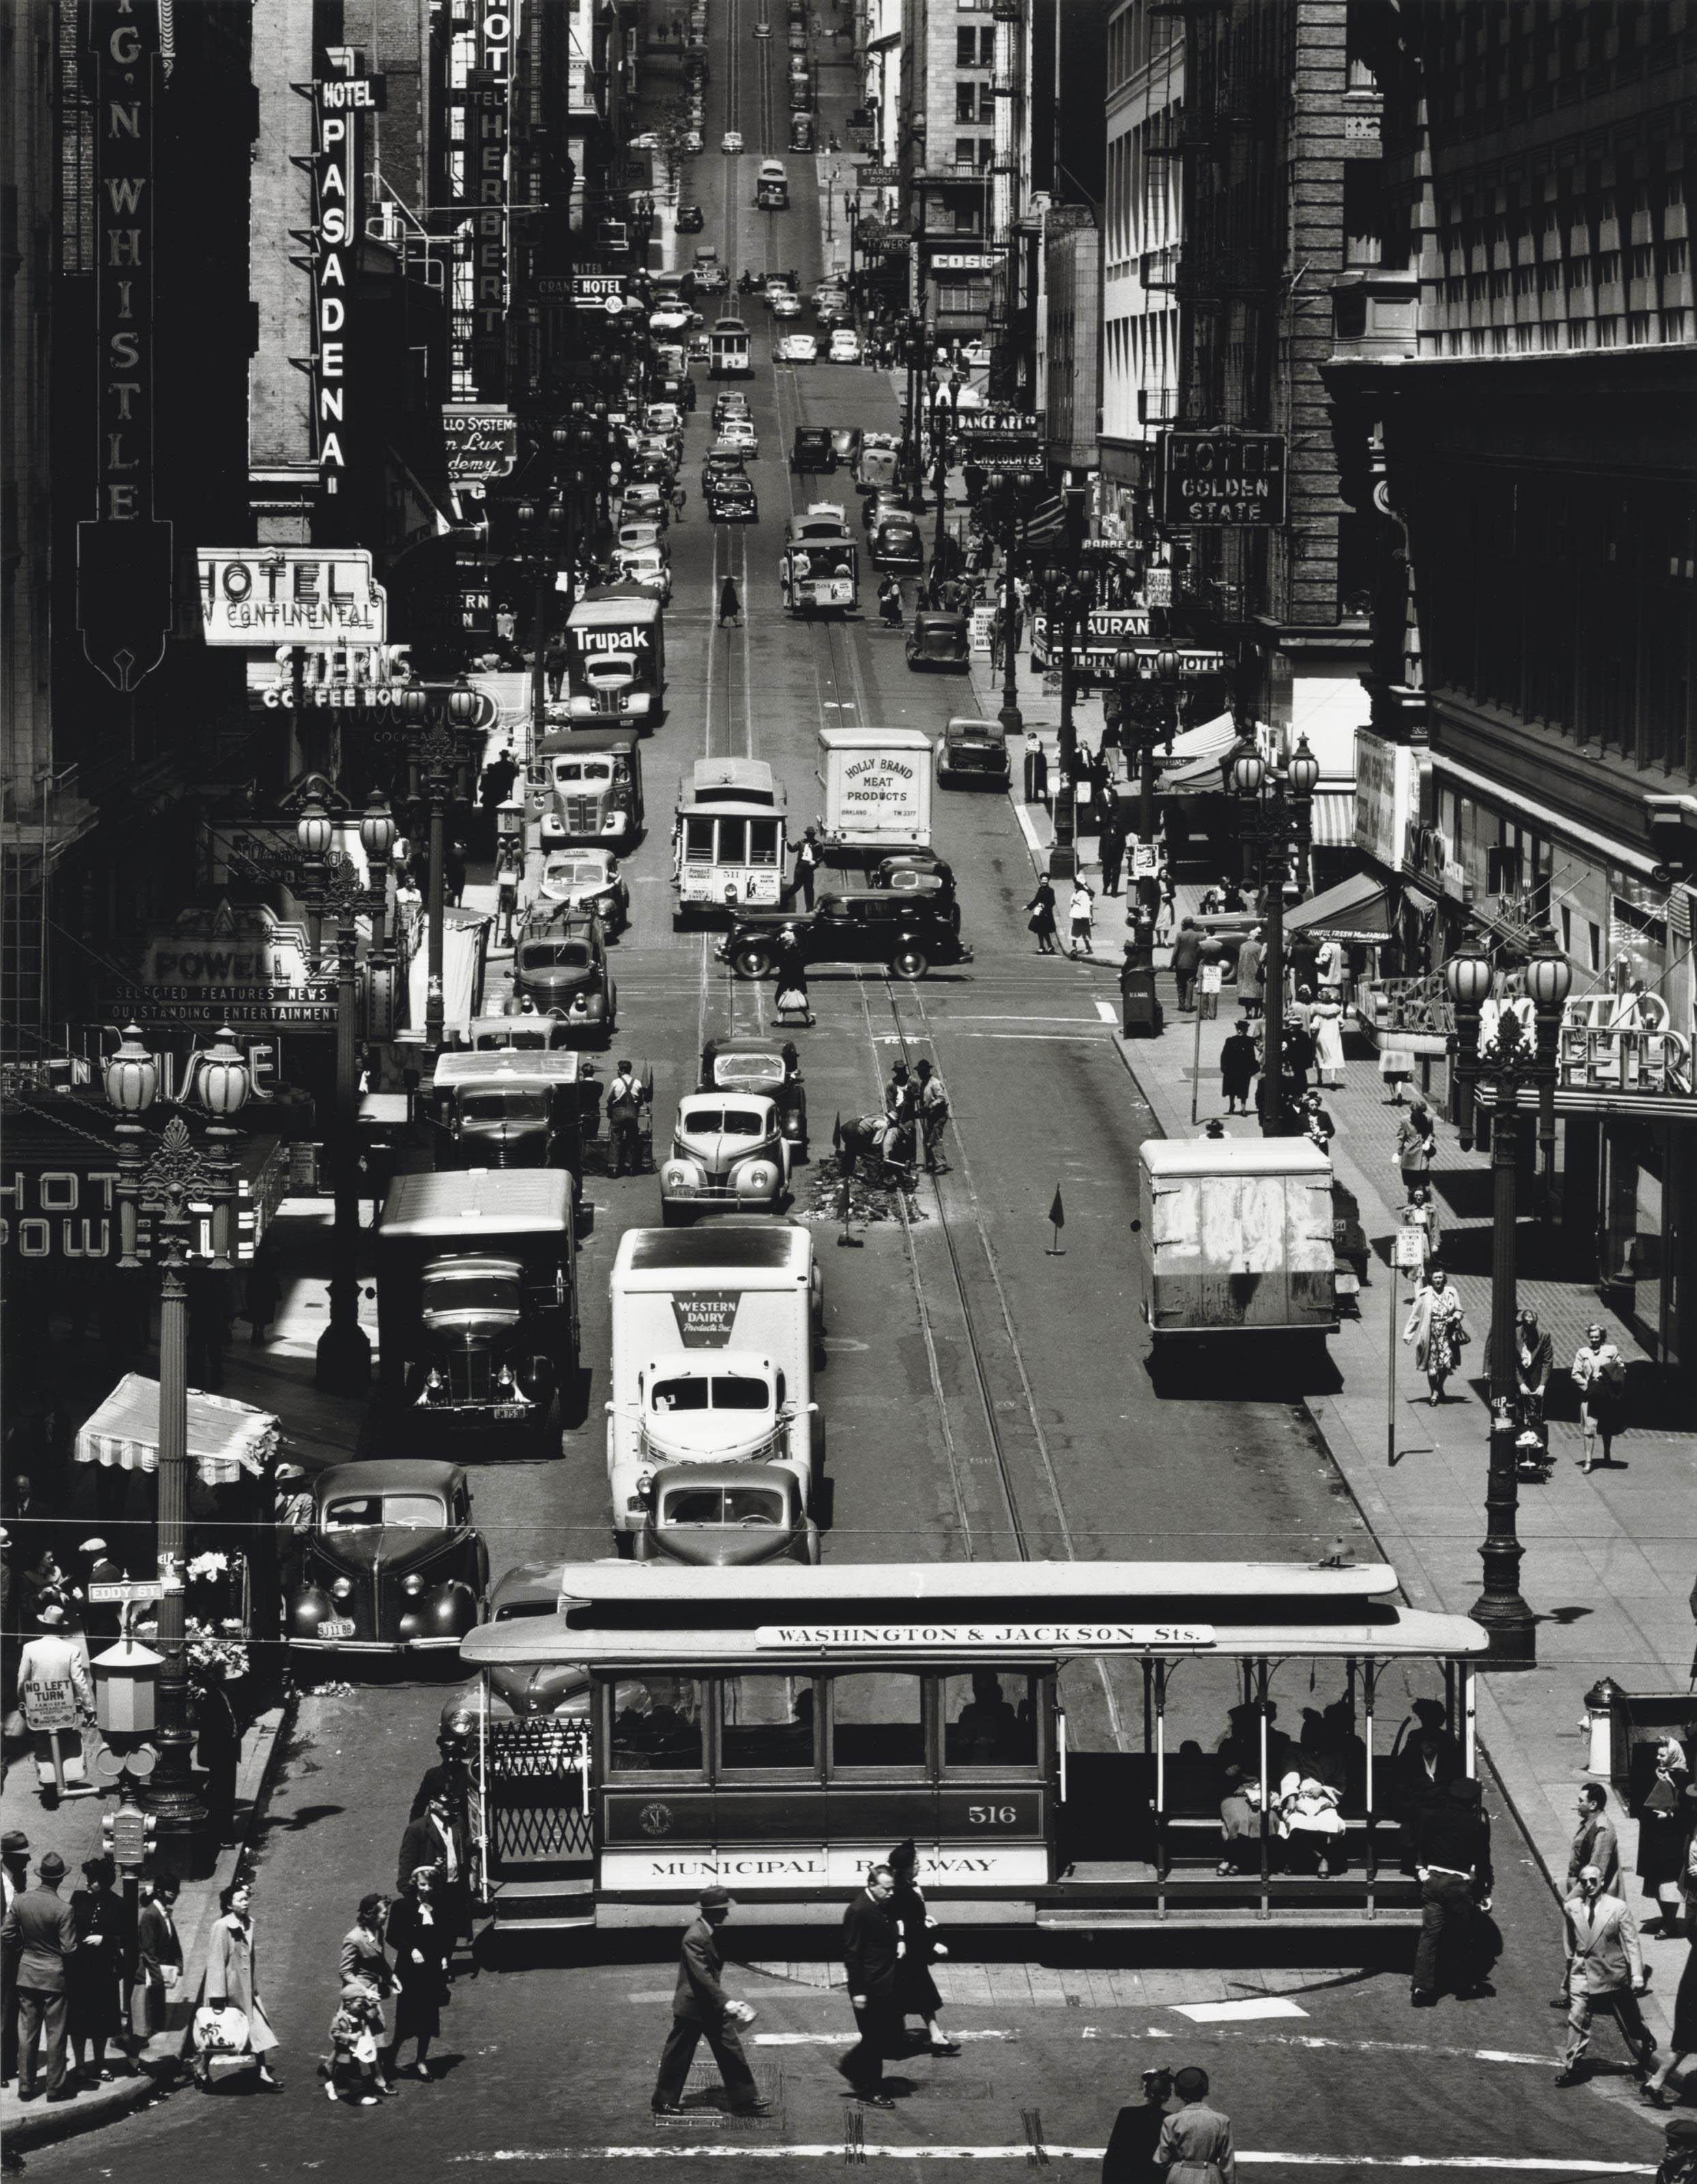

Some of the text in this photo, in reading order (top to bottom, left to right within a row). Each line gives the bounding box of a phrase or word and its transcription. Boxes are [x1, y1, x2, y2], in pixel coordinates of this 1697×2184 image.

[323, 81, 375, 107] HOTEL
[479, 115, 502, 332] HERBERT
[321, 119, 346, 466] PASADENA
[538, 280, 622, 293] CRANE HOTEL
[104, 178, 145, 520] WHISTLE
[467, 417, 512, 431] SYSTEM
[958, 414, 996, 429] DANCE
[1000, 414, 1022, 429] ART
[461, 432, 505, 451] Lux
[974, 452, 1042, 465] CHOCOLATES
[1172, 442, 1279, 471] HOTEL
[1182, 478, 1268, 497] GOLDEN
[1189, 502, 1261, 520] STATE
[198, 562, 354, 605] HOTEL
[227, 603, 375, 629] CONTINENTAL
[572, 627, 649, 655] Trupak
[365, 688, 401, 707] HOU
[845, 759, 913, 779] HOLLY BRAND
[863, 777, 893, 786] MEAT
[847, 792, 907, 801] PRODUCTS
[723, 870, 739, 878] 511
[115, 987, 328, 1001] SELECTED FEATURES NEWS
[112, 1005, 338, 1021] OUTSTANDING ENTERTAINMENT
[678, 1302, 736, 1312] WESTERN
[687, 1312, 725, 1323] DAIRY
[683, 1323, 717, 1332] Products
[92, 1585, 160, 1599] EDDY ST.
[779, 1627, 1200, 1642] WASHINGTON & JACKSON Sts.
[26, 1680, 70, 1693] NO LEFT
[35, 1691, 64, 1701] TURN
[968, 1805, 1017, 1824] 516
[651, 1858, 998, 1875] MUNICIPAL RWAY
